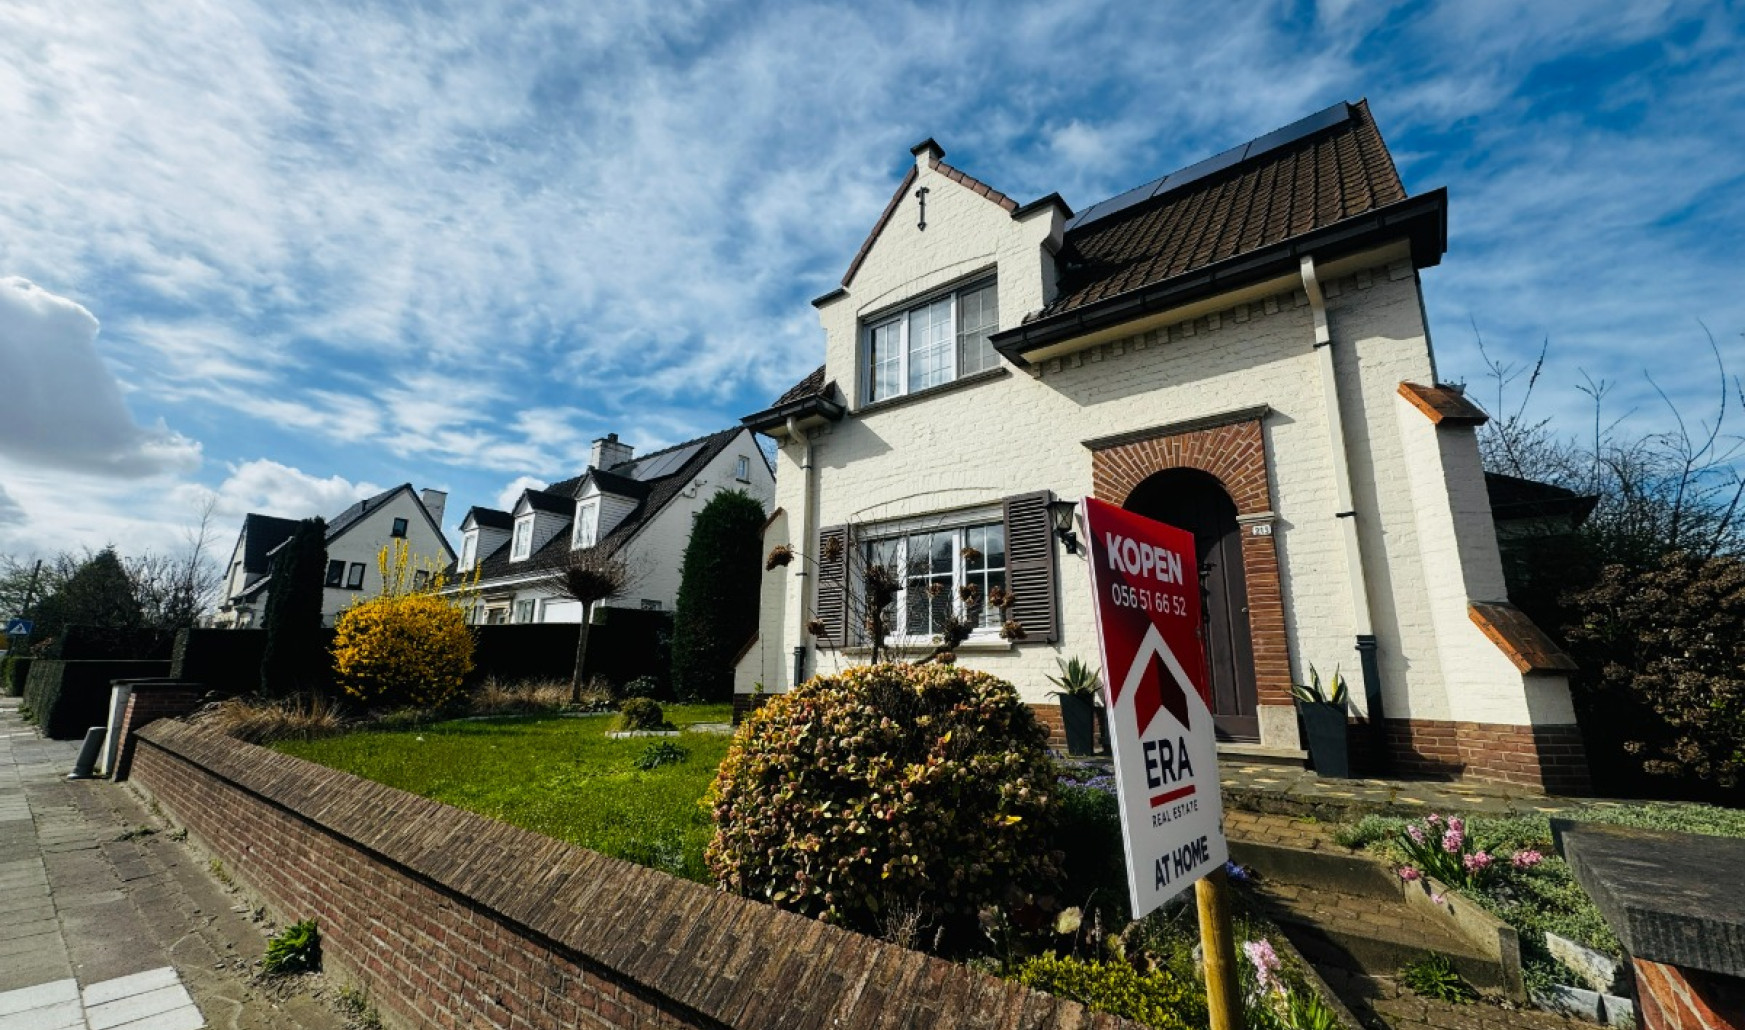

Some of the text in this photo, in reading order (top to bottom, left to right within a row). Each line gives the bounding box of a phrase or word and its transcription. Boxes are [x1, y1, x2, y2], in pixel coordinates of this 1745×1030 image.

[1105, 531, 1183, 585] KOPEN
[1111, 582, 1187, 617] 056 51 66 52
[1142, 736, 1194, 789] ERA
[1152, 799, 1199, 828] REAL ESTATE
[1155, 835, 1210, 891] AT HOME
